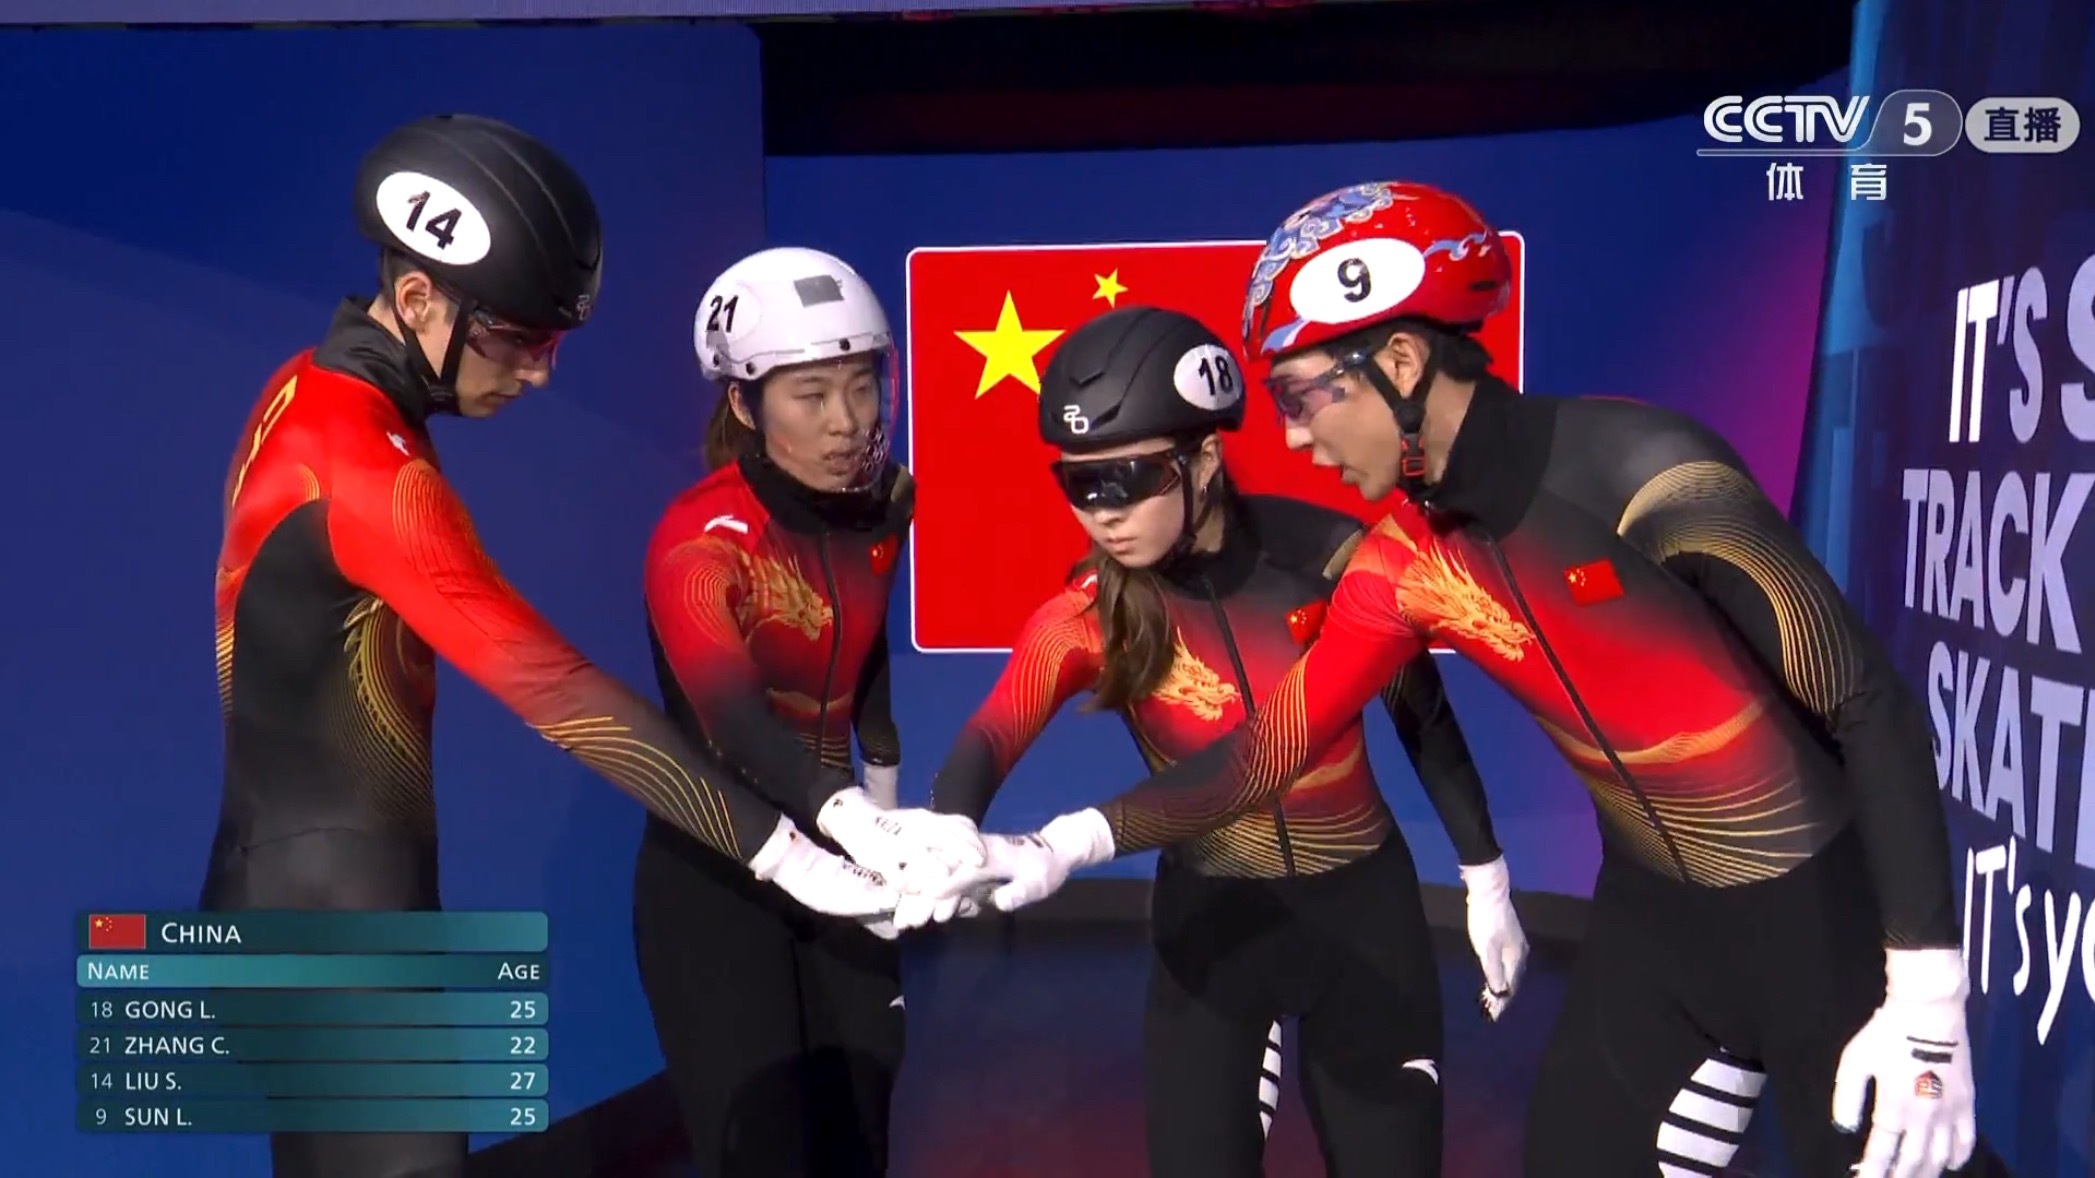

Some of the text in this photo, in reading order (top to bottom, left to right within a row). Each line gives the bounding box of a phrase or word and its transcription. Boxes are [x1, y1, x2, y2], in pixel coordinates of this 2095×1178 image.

[406, 191, 462, 250] 14
[1337, 258, 1372, 302] 9
[706, 295, 739, 332] 21
[1198, 356, 1234, 396] 18
[1948, 267, 2048, 443] IT'S
[1903, 469, 2095, 653] TRACK
